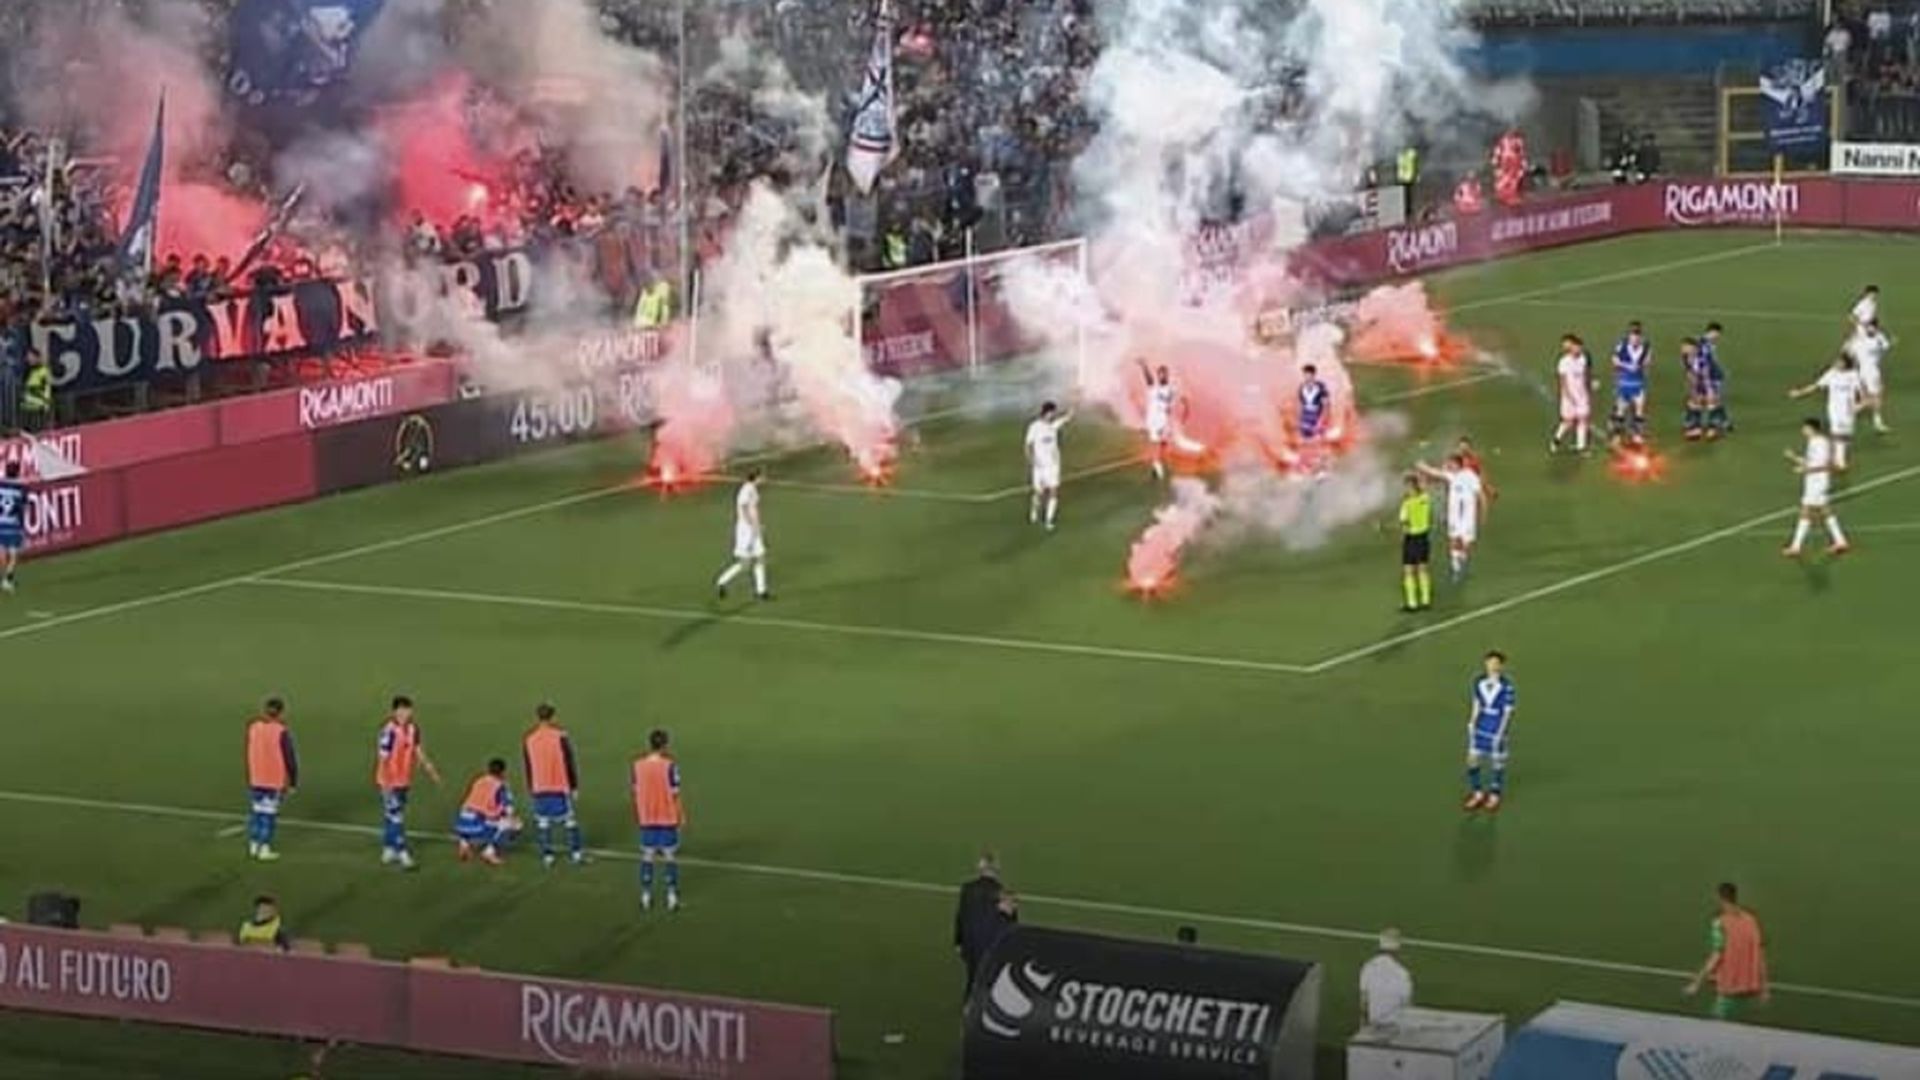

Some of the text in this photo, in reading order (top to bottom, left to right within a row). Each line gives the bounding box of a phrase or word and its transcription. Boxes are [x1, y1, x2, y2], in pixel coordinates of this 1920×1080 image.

[1845, 148, 1904, 167] Nanni
[1665, 183, 1798, 225] RIGAMONTI
[1387, 221, 1457, 273] RIGAMONTI
[31, 295, 307, 386] CURVA
[300, 377, 393, 430] RIGAMONTI
[16, 944, 49, 990] AL
[60, 949, 171, 1002] FUTURO
[522, 983, 745, 1064] RIGAMONTI
[1055, 980, 1270, 1043] STOCCHETTI
[1051, 1025, 1257, 1064] BEVERAGE SERVICE
